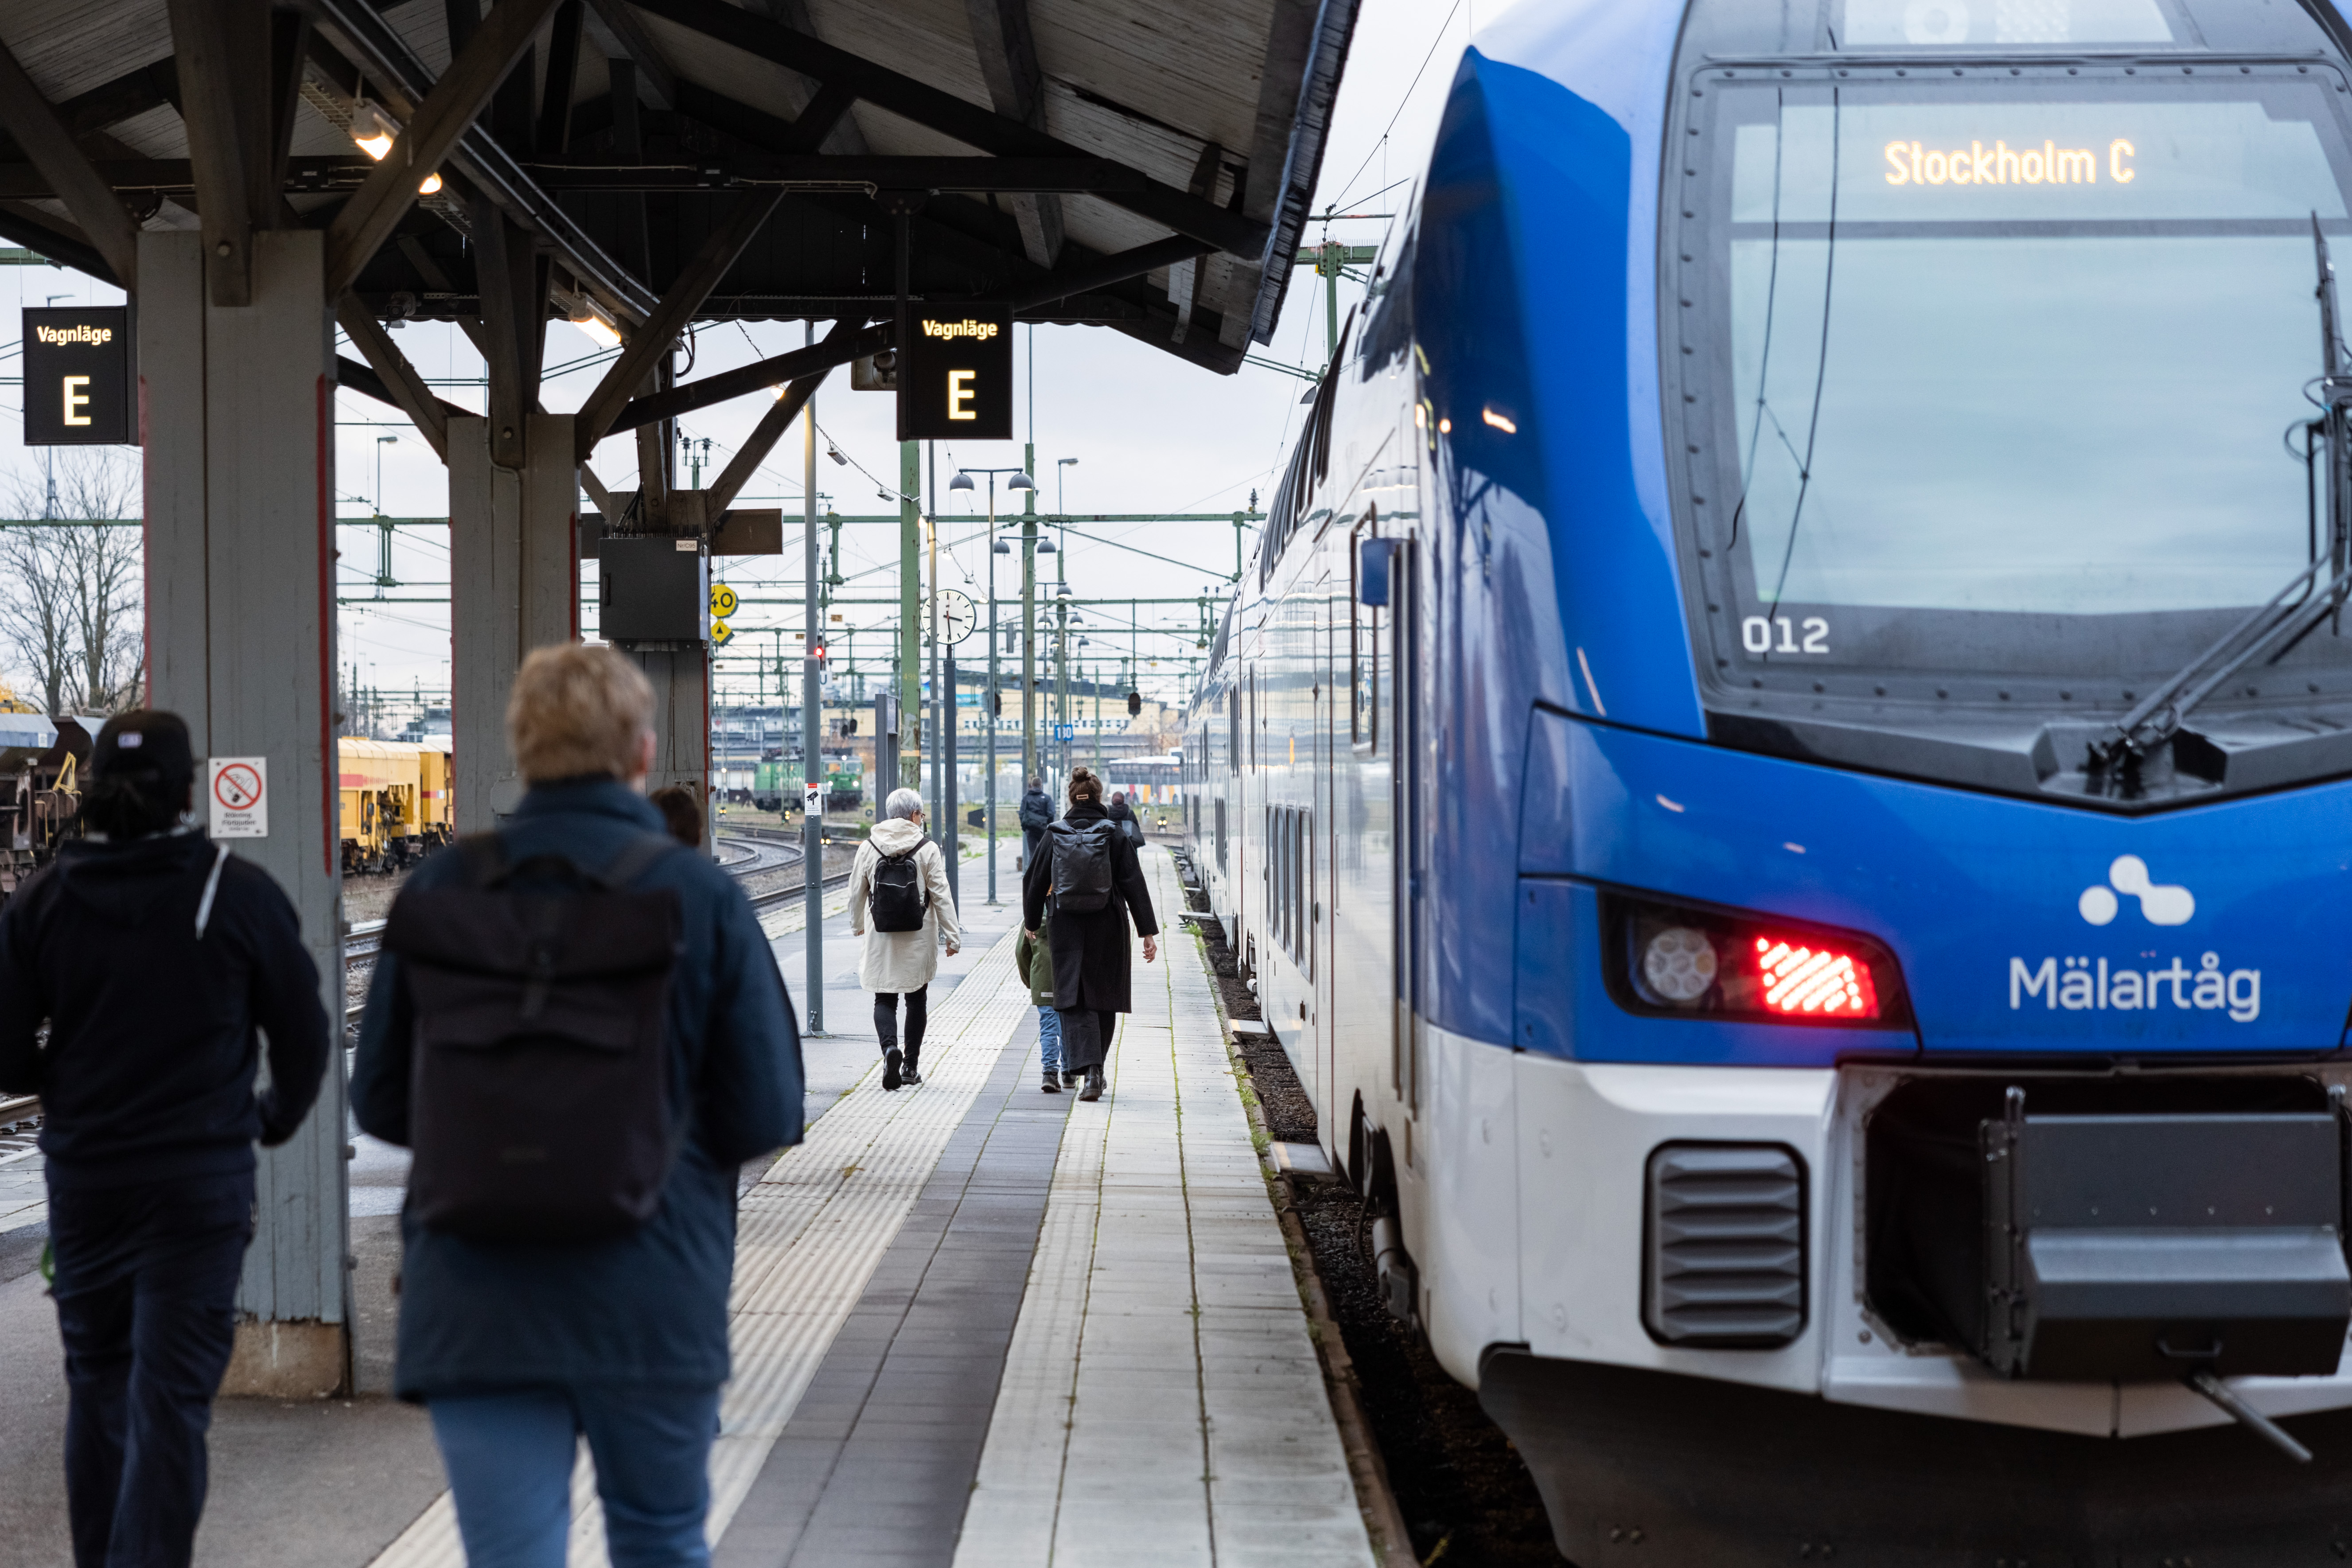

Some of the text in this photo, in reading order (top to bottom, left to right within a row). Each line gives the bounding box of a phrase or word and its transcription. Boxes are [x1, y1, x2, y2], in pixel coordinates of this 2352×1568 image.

[1885, 139, 2134, 185] Stockholm C
[37, 325, 111, 346] Vagnläge
[923, 319, 997, 340] Vagnläge
[63, 376, 91, 425] E
[948, 370, 976, 420] E
[1742, 616, 1829, 653] 012
[2009, 951, 2261, 1022] Mälartåg
